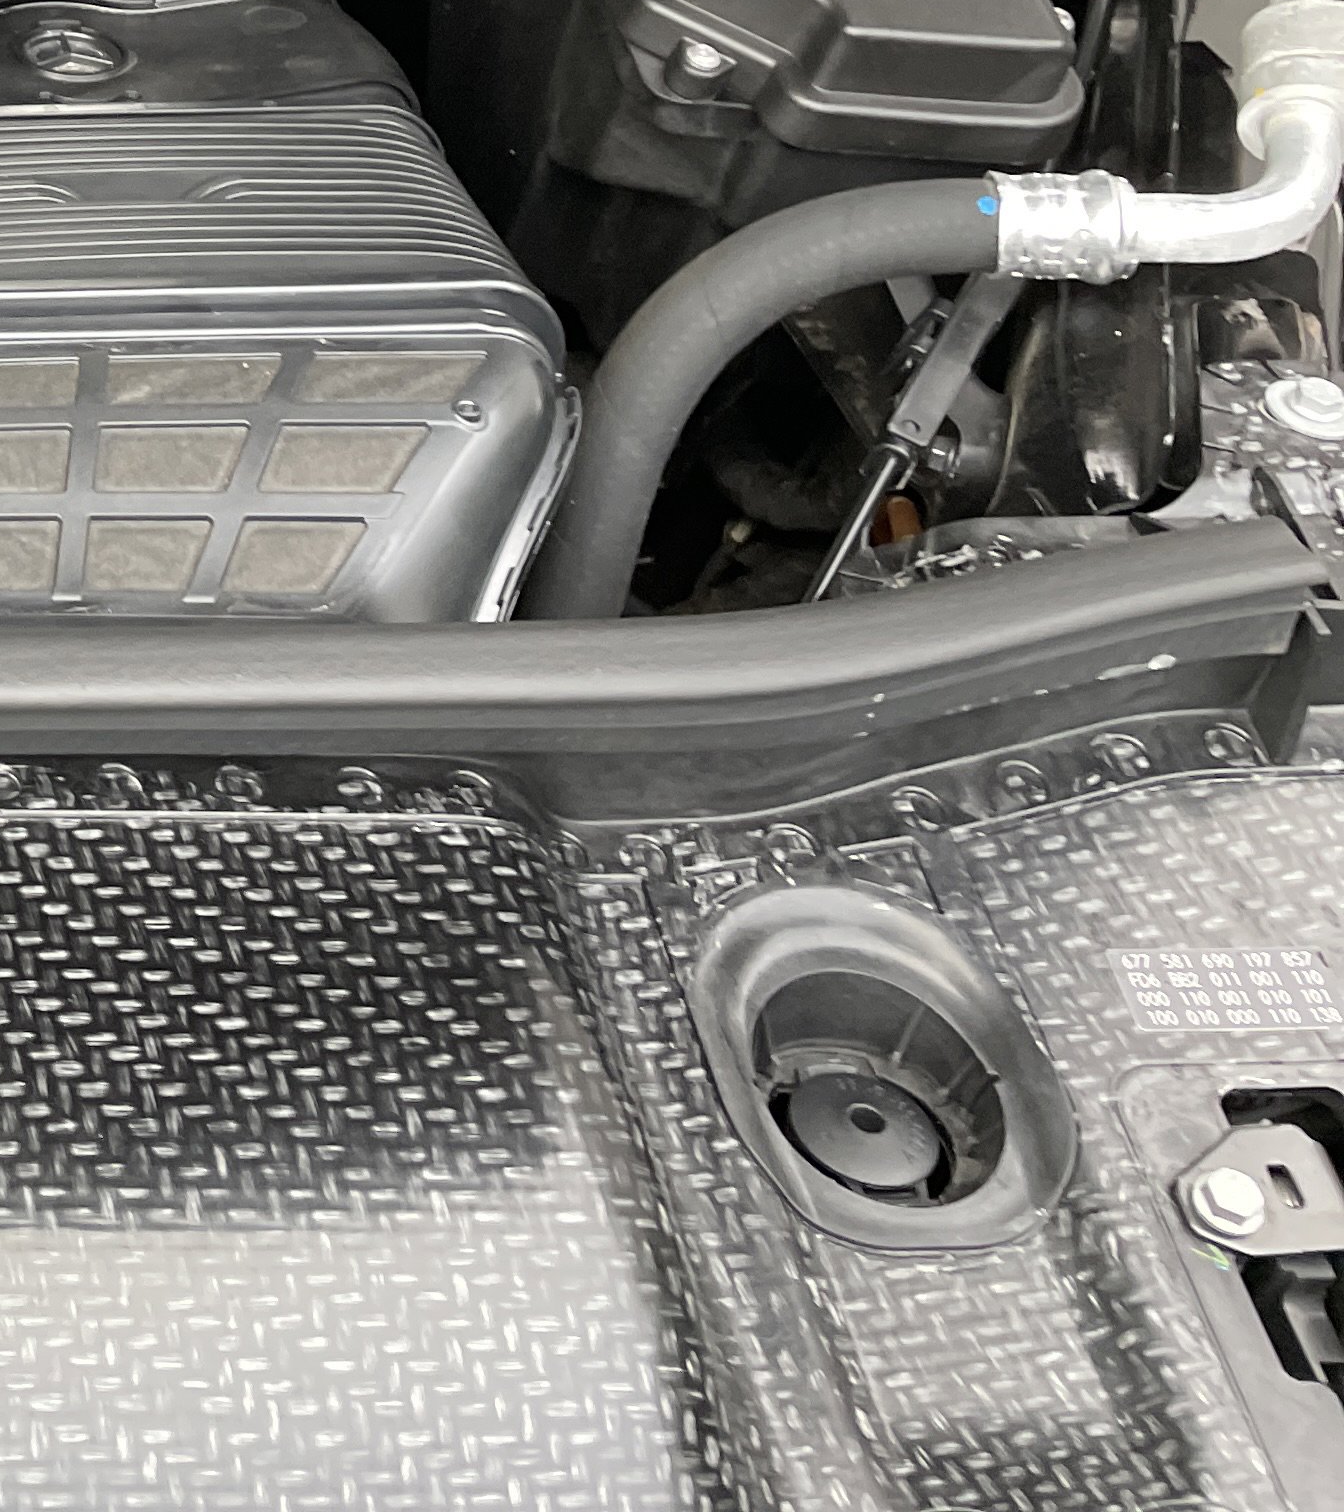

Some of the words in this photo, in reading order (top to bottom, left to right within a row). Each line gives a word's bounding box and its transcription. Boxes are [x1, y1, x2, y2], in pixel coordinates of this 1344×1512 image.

[1120, 953, 1150, 970] 677
[1159, 953, 1194, 969] 581
[1201, 952, 1235, 969] 690
[1241, 951, 1272, 968] 197
[1208, 971, 1243, 988] 011
[1248, 970, 1284, 987] 001
[1290, 969, 1326, 986] 110
[1136, 990, 1171, 1007] 000
[1178, 990, 1212, 1007] 110
[1217, 990, 1252, 1006] 001
[1257, 989, 1293, 1006] 010
[1299, 988, 1334, 1004] 101
[1146, 1009, 1180, 1026] 100
[1185, 1009, 1221, 1026] 010
[1226, 1008, 1261, 1025] 000
[1268, 1008, 1302, 1024] 110
